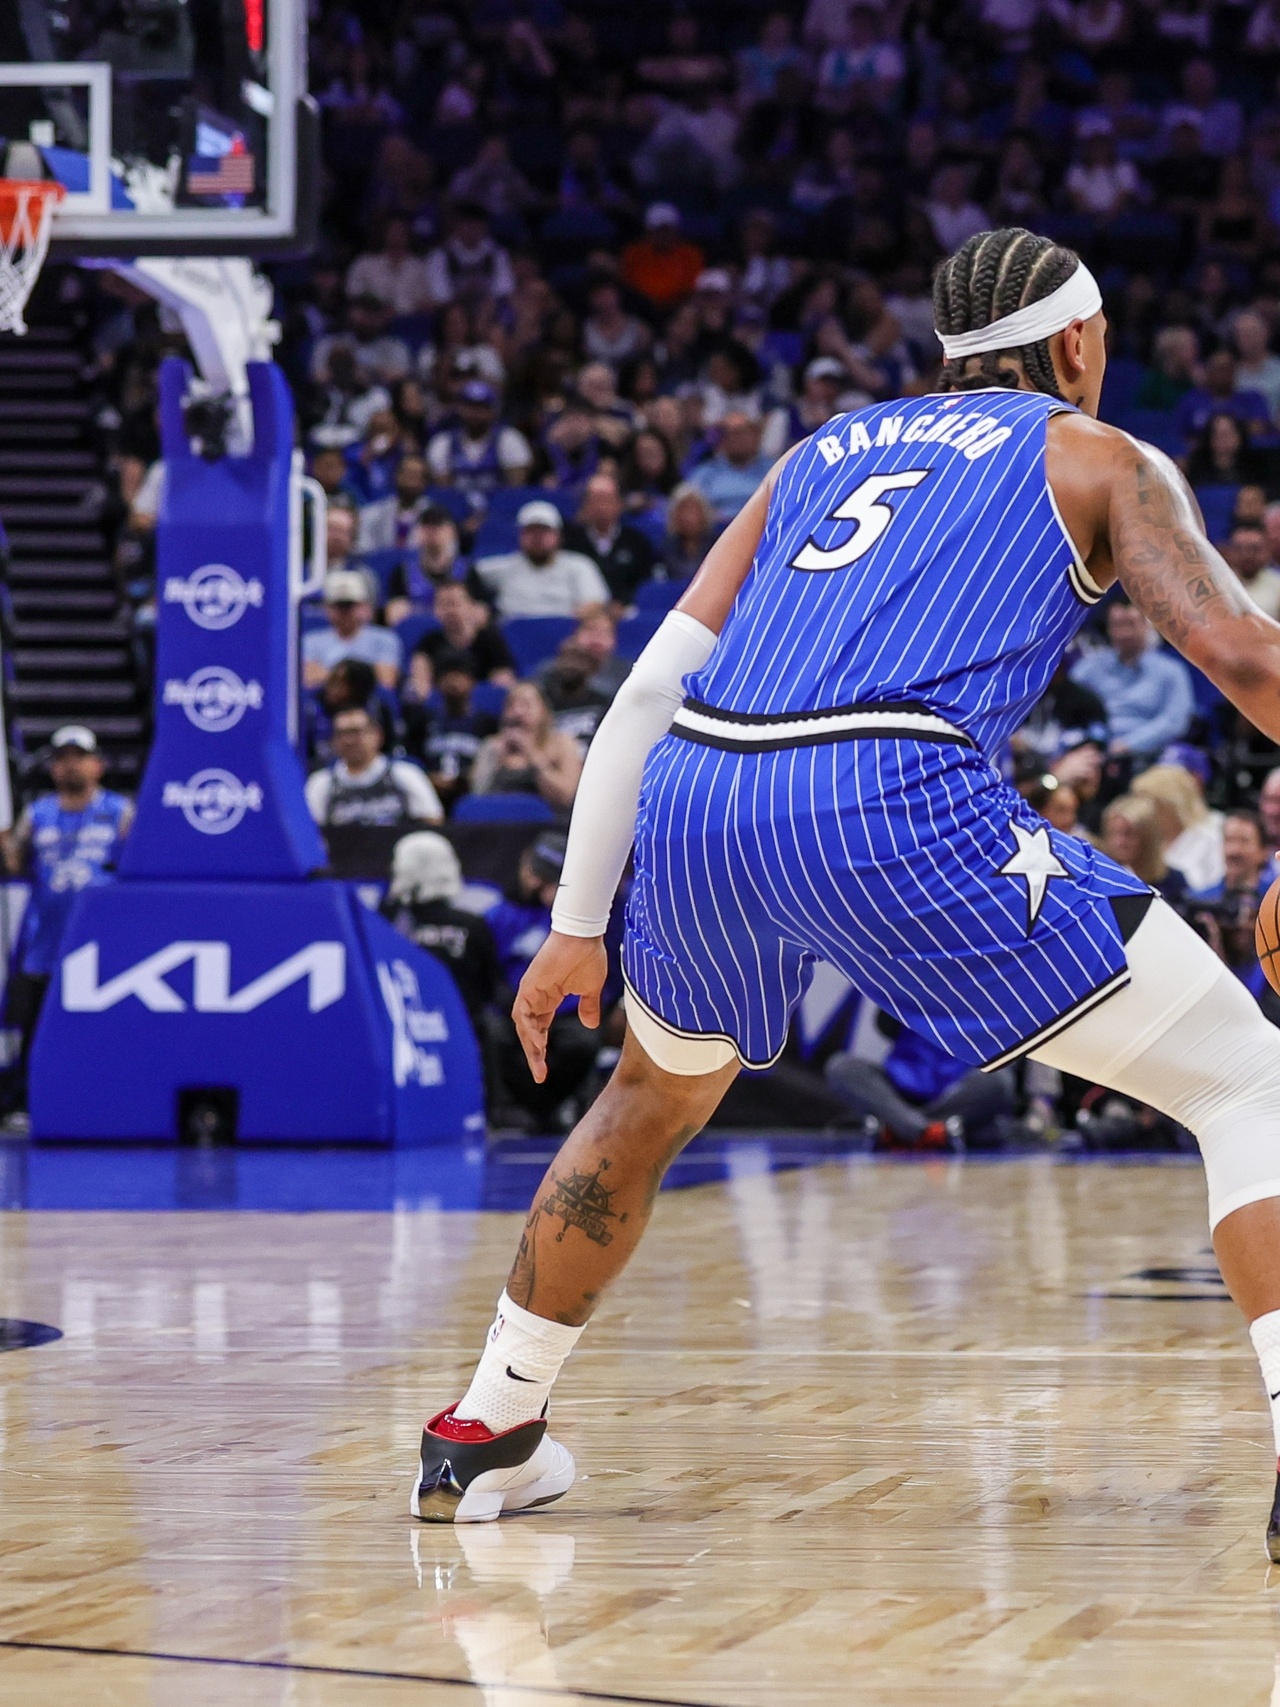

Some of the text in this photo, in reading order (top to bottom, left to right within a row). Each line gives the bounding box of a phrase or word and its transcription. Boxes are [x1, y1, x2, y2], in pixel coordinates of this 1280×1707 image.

[816, 412, 1012, 466] BANCHERO
[786, 468, 935, 573] 5
[61, 940, 347, 1014] KIA
